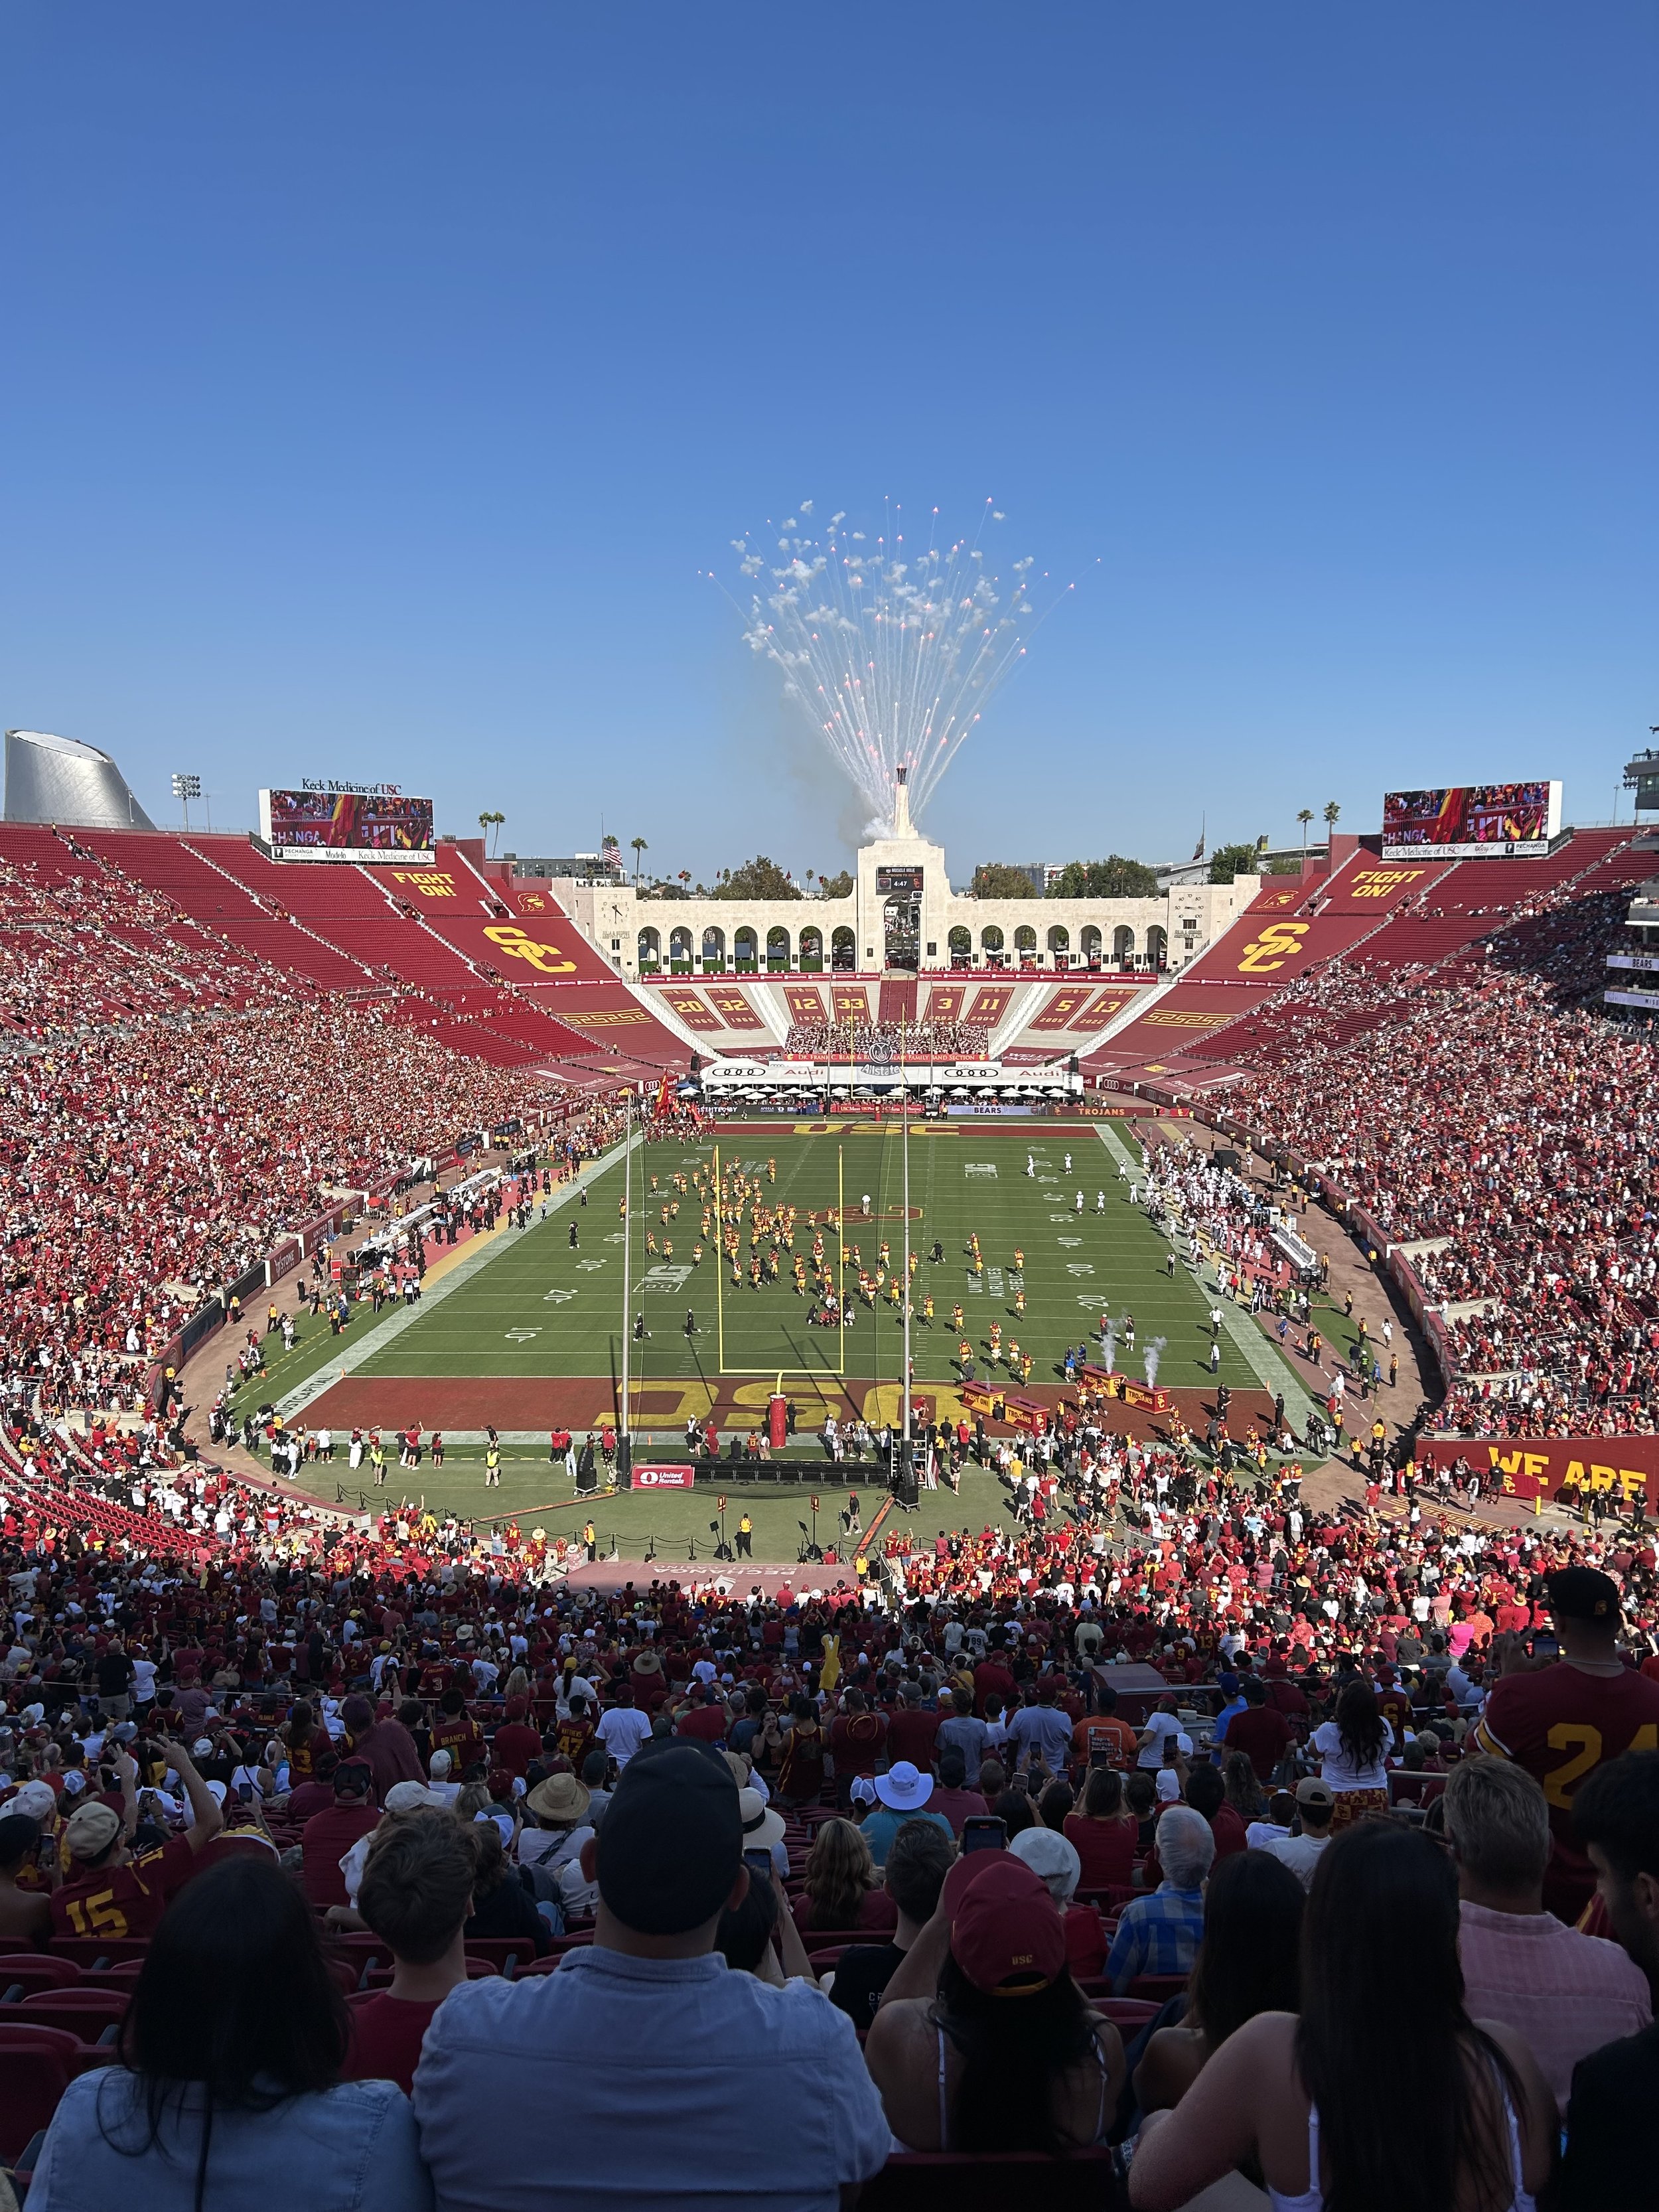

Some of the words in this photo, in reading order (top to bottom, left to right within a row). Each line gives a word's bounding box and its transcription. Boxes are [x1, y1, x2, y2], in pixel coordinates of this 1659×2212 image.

[301, 778, 325, 790] Keck
[328, 780, 369, 793] Medicine
[370, 783, 380, 793] of
[381, 784, 401, 795] USC
[392, 872, 456, 885] FIGHT
[1350, 870, 1426, 883] FIGHT
[417, 885, 457, 897] ON!
[1351, 885, 1396, 897] ON!
[482, 926, 577, 973] SC
[1237, 922, 1311, 972] SC
[1632, 958, 1652, 969] BEARS
[673, 1000, 705, 1013] 20
[716, 999, 749, 1011] 32
[792, 998, 819, 1009] 12
[836, 998, 865, 1009] 33
[937, 997, 953, 1009] 3
[979, 998, 1000, 1010] 11
[1055, 999, 1076, 1012] 5
[1091, 1001, 1121, 1013] 13
[861, 1063, 901, 1076] Allstate
[793, 1124, 960, 1136] USC
[1049, 1214, 1075, 1222] 50
[1056, 1237, 1085, 1246] 40
[575, 1258, 608, 1270] 30
[1066, 1264, 1096, 1275] 30
[986, 1267, 1005, 1298] AIRLINES
[543, 1289, 579, 1302] 20
[1076, 1295, 1110, 1308] 20
[504, 1327, 543, 1340] 10
[965, 1392, 979, 1404] FIGHT
[1128, 1390, 1153, 1405] TROJANS
[1157, 1394, 1165, 1409] SC
[1007, 1409, 1032, 1425] TROJANS
[1036, 1414, 1045, 1428] SC
[1488, 1446, 1550, 1486] WE
[1563, 1460, 1647, 1502] ARE
[1503, 1475, 1516, 1494] SC
[508, 1530, 518, 1538] 14
[976, 1550, 983, 1560] 9
[1297, 1556, 1304, 1565] 2
[911, 1574, 917, 1584] 1
[937, 1572, 944, 1582] 8
[717, 1600, 725, 1609] 7
[220, 1611, 228, 1621] 9
[971, 1637, 982, 1646] 89
[1199, 1636, 1213, 1648] 13
[1177, 1648, 1185, 1660] 9
[350, 1659, 358, 1670] 2
[432, 1678, 443, 1691] 3
[1383, 1702, 1399, 1728] 6
[441, 1732, 467, 1745] BRANCH
[558, 1735, 585, 1759] 47
[65, 1887, 128, 1938] 15
[1011, 1954, 1033, 1966] USC
